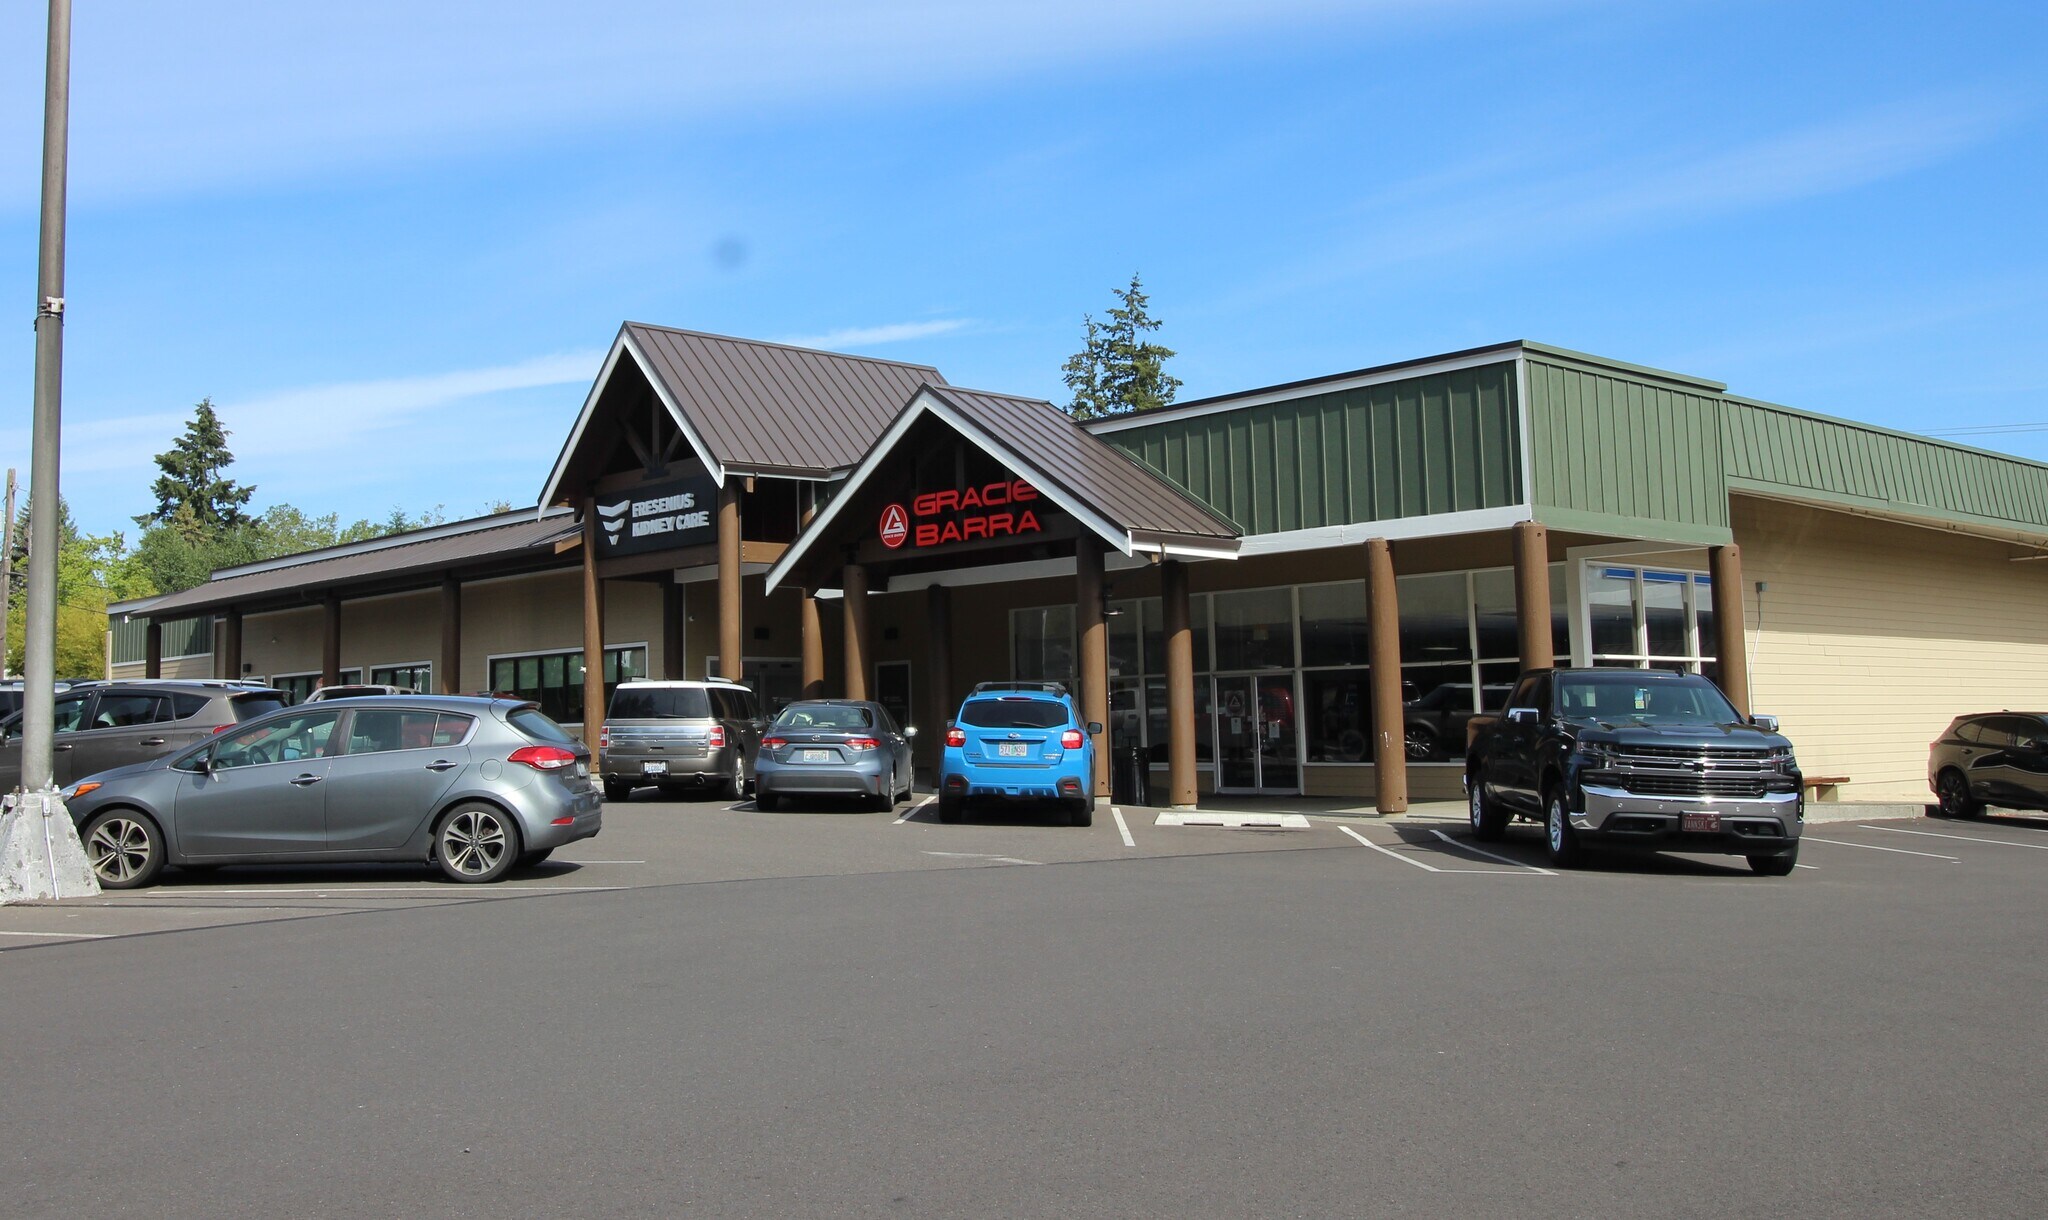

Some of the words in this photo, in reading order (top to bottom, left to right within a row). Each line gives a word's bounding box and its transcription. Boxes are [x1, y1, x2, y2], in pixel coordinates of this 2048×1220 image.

[632, 493, 694, 517] FRESENIUS
[913, 480, 1038, 516] GRACIE
[676, 510, 710, 530] CARE
[916, 510, 1041, 546] BARRA
